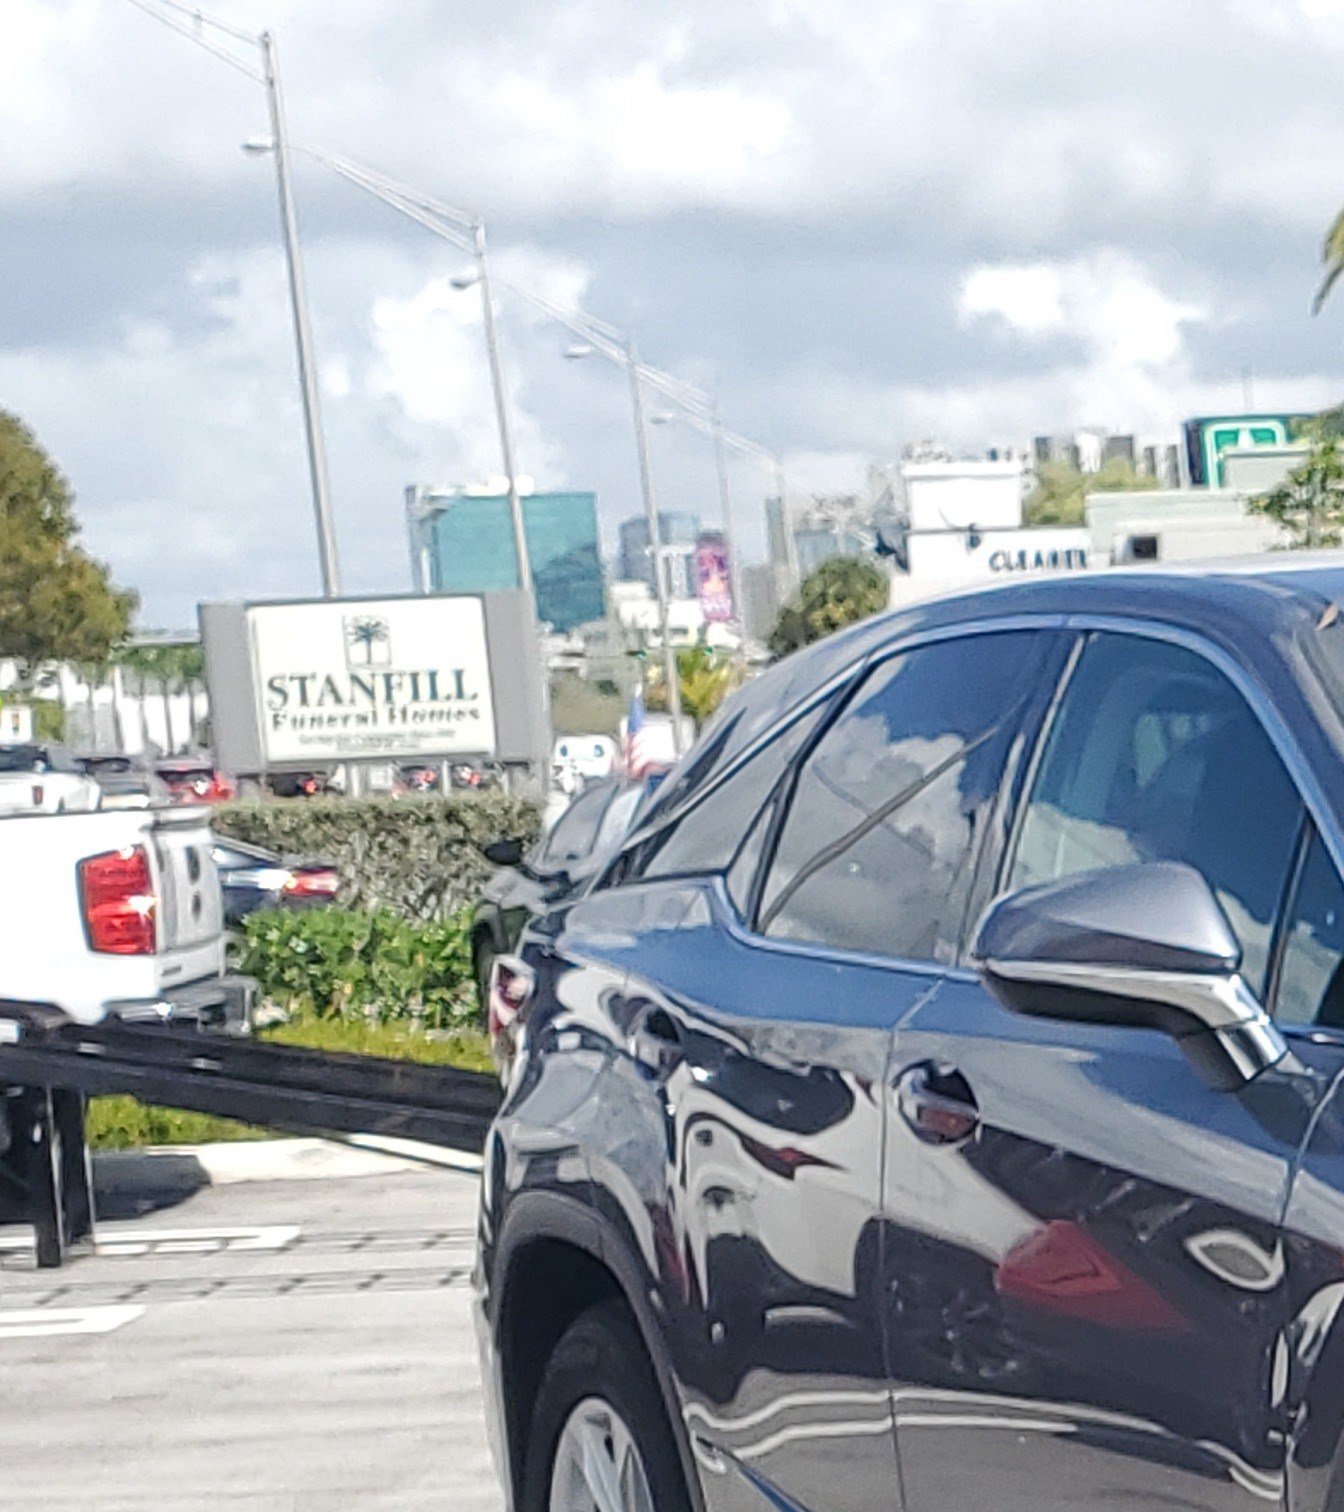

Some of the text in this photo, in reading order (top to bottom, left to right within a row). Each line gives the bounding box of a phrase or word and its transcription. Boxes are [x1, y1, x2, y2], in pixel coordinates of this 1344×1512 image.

[267, 668, 479, 711] STANFILL
[271, 705, 480, 731] Funeral Homes
